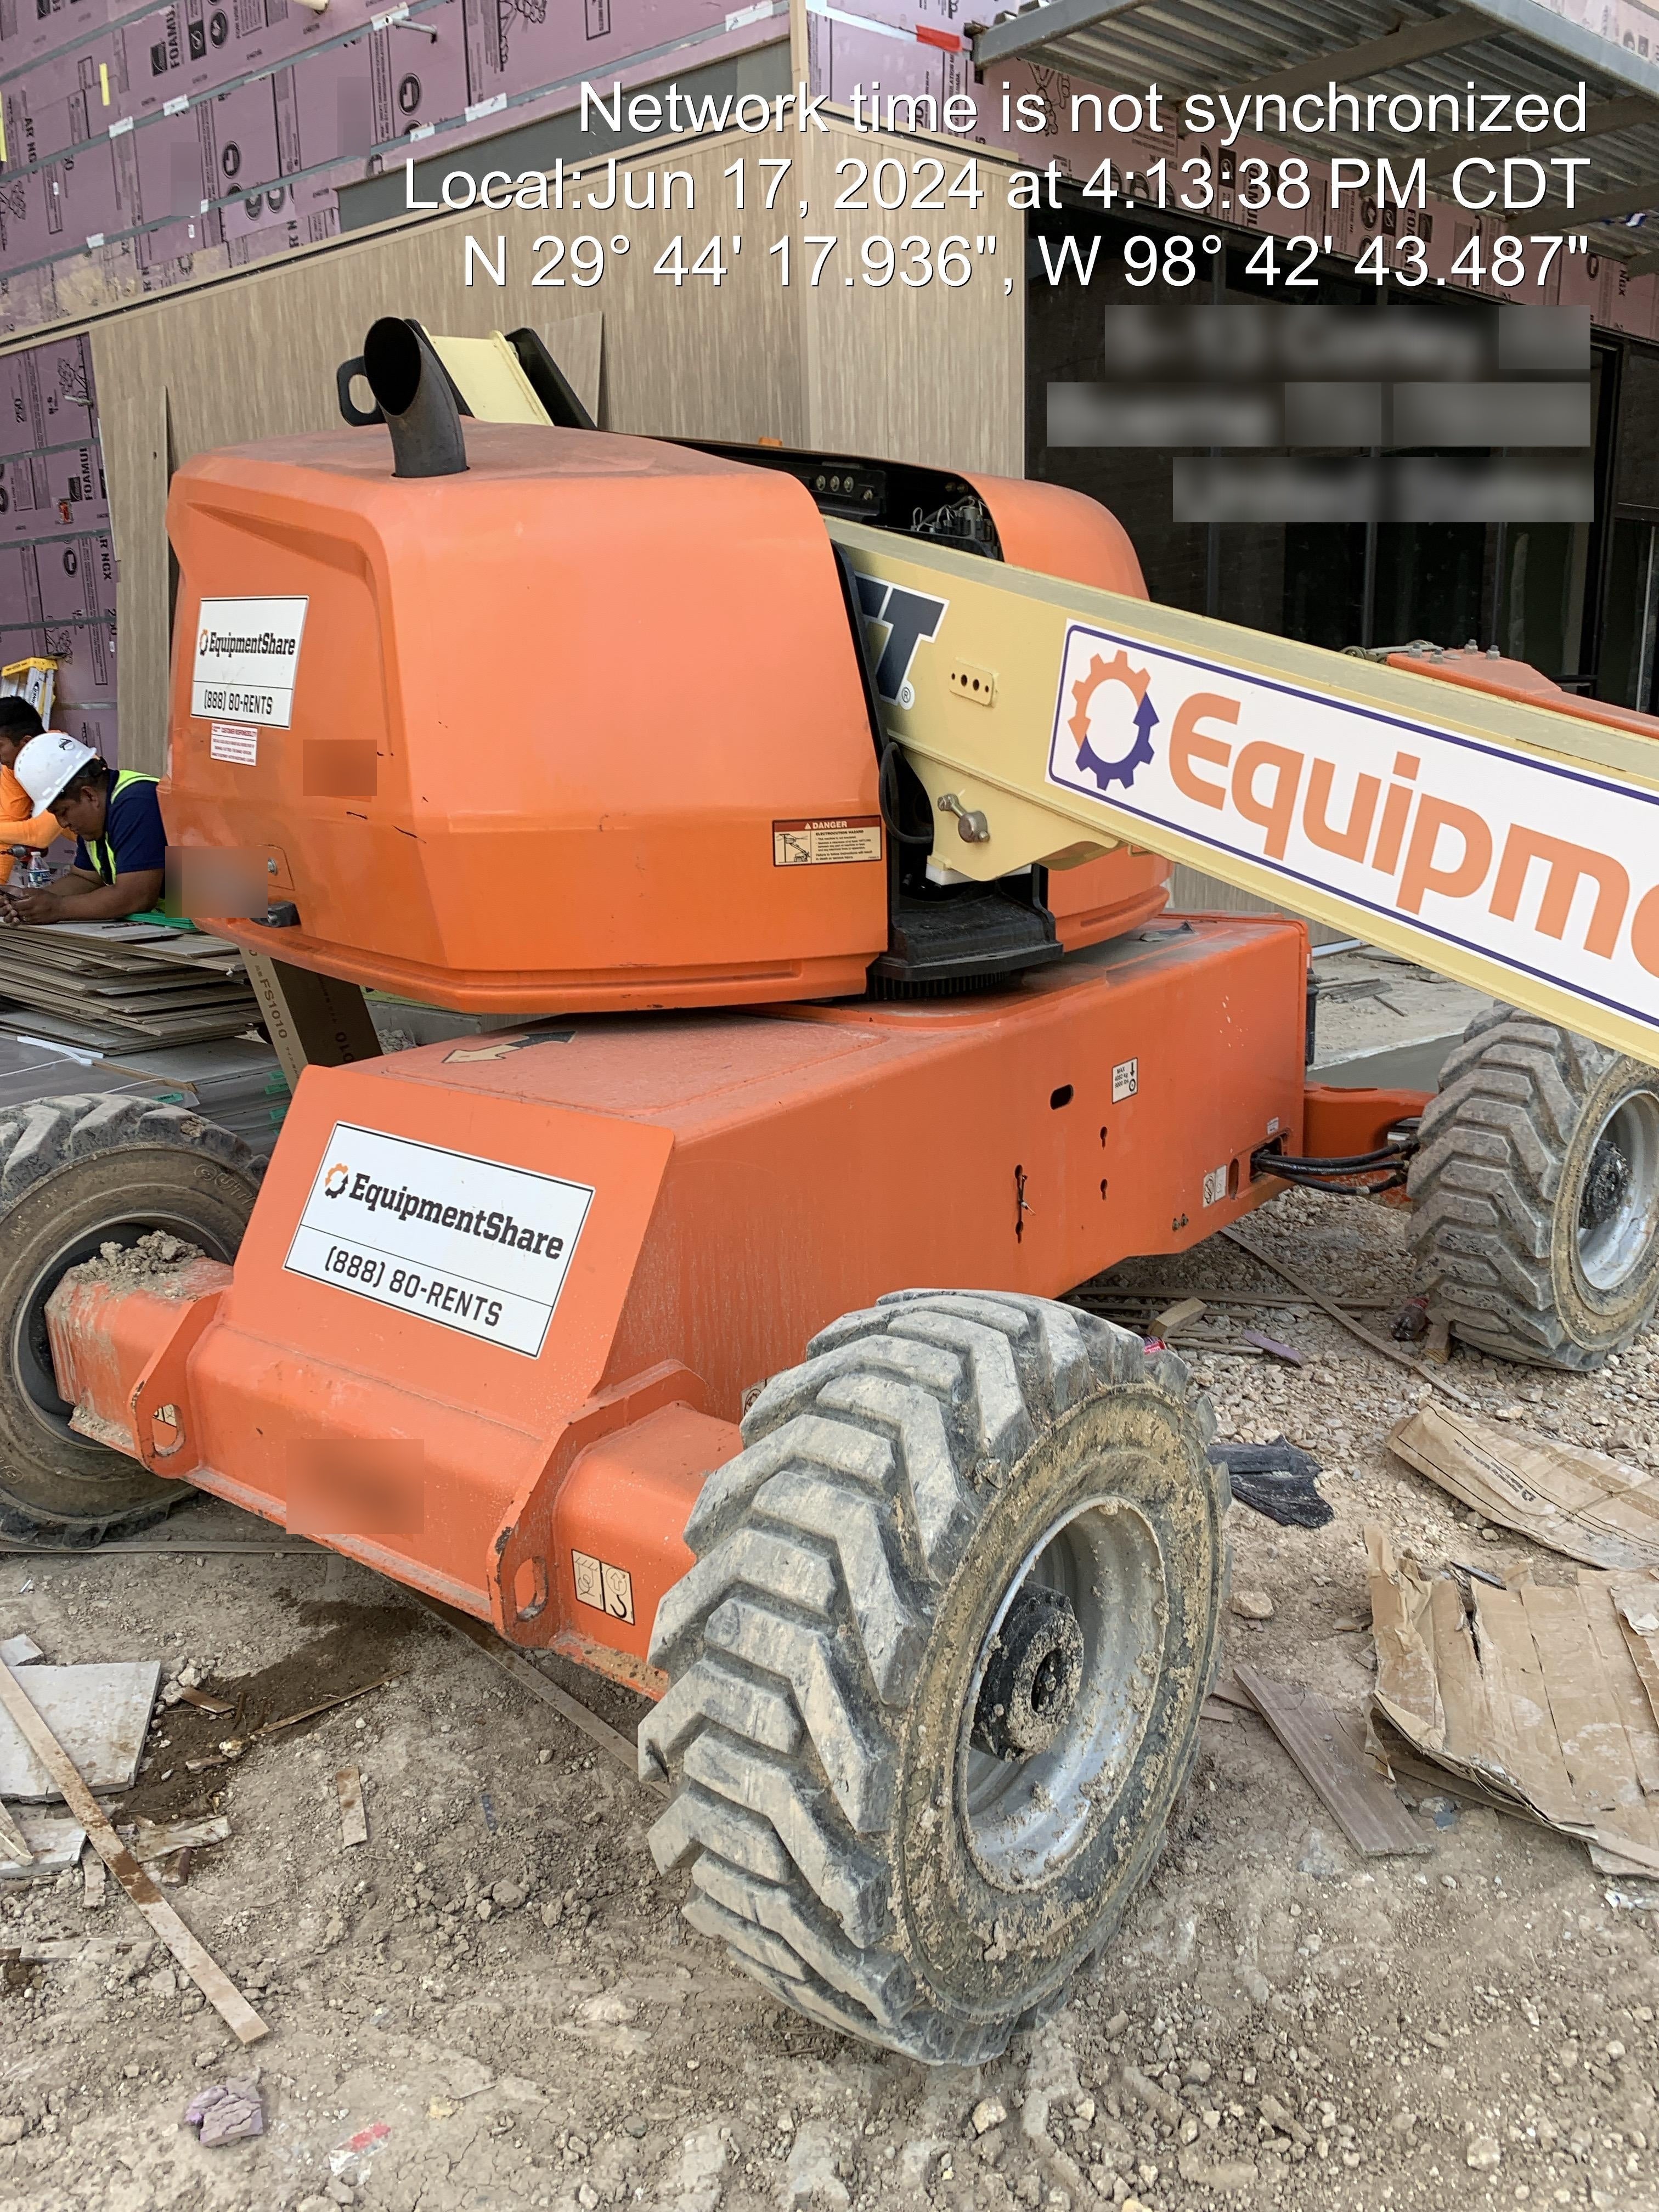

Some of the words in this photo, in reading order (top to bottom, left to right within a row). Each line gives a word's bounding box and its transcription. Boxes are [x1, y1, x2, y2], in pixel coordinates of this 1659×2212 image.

[166, 4, 179, 69] FOAMU
[209, 631, 295, 657] EquipmentShare
[204, 689, 226, 711] (888)
[228, 693, 273, 715] 80-RENTS
[812, 821, 847, 829] DANGER
[260, 978, 288, 1039] FS1010
[349, 1173, 564, 1260] EquipmentShare
[325, 1246, 385, 1288] (888)
[390, 1269, 503, 1327] 80-RENTS
